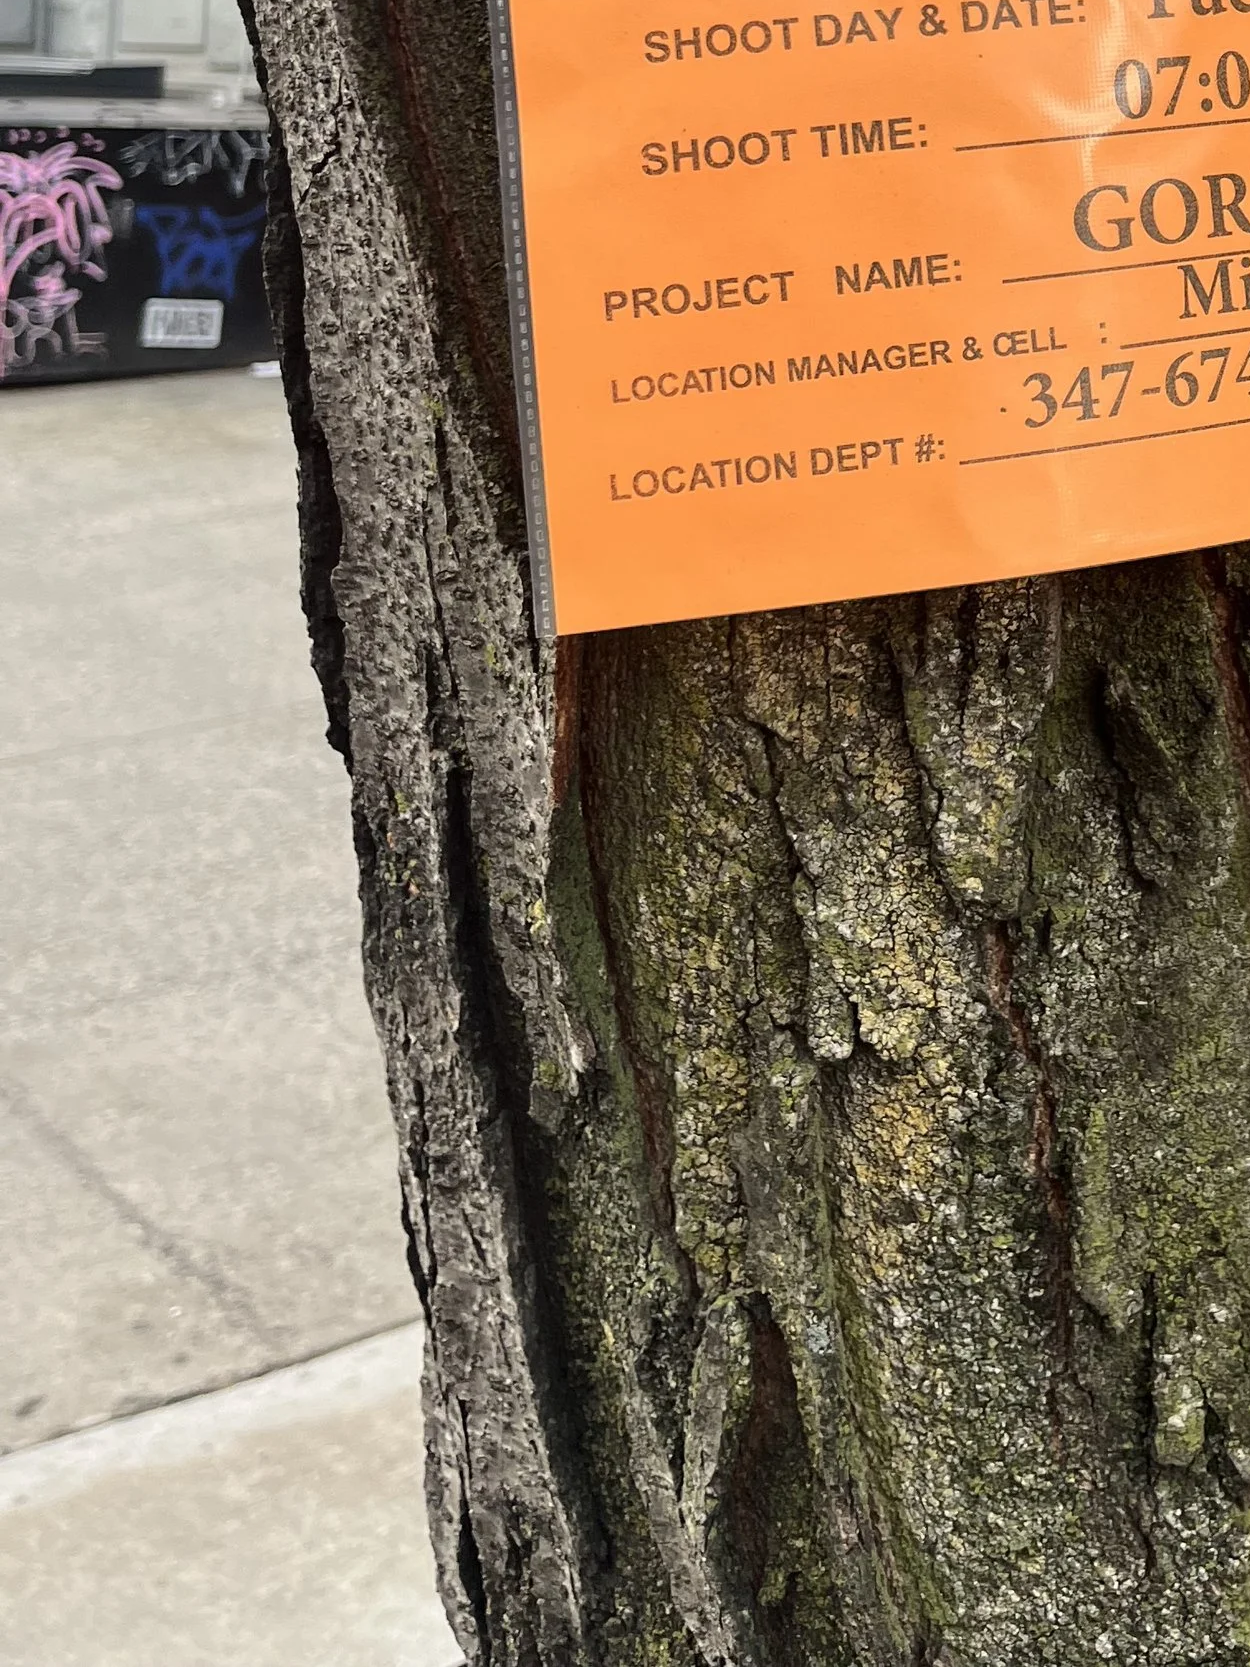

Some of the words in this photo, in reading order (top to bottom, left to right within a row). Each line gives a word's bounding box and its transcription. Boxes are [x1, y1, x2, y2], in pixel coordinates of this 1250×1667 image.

[644, 17, 799, 64] SHOOT
[813, 7, 903, 47] DAY
[918, 3, 948, 37] &
[640, 128, 798, 176] SHOOT
[809, 116, 928, 158] TIME:
[603, 270, 795, 322] PROJECT
[834, 253, 962, 296] NAME:
[611, 360, 776, 404] LOCATION
[786, 339, 953, 383] MANAGER
[961, 336, 985, 362] &
[992, 326, 1068, 357] CELL
[609, 450, 798, 501] LOCATION
[810, 437, 905, 476] DEPT
[914, 433, 946, 464] #:
